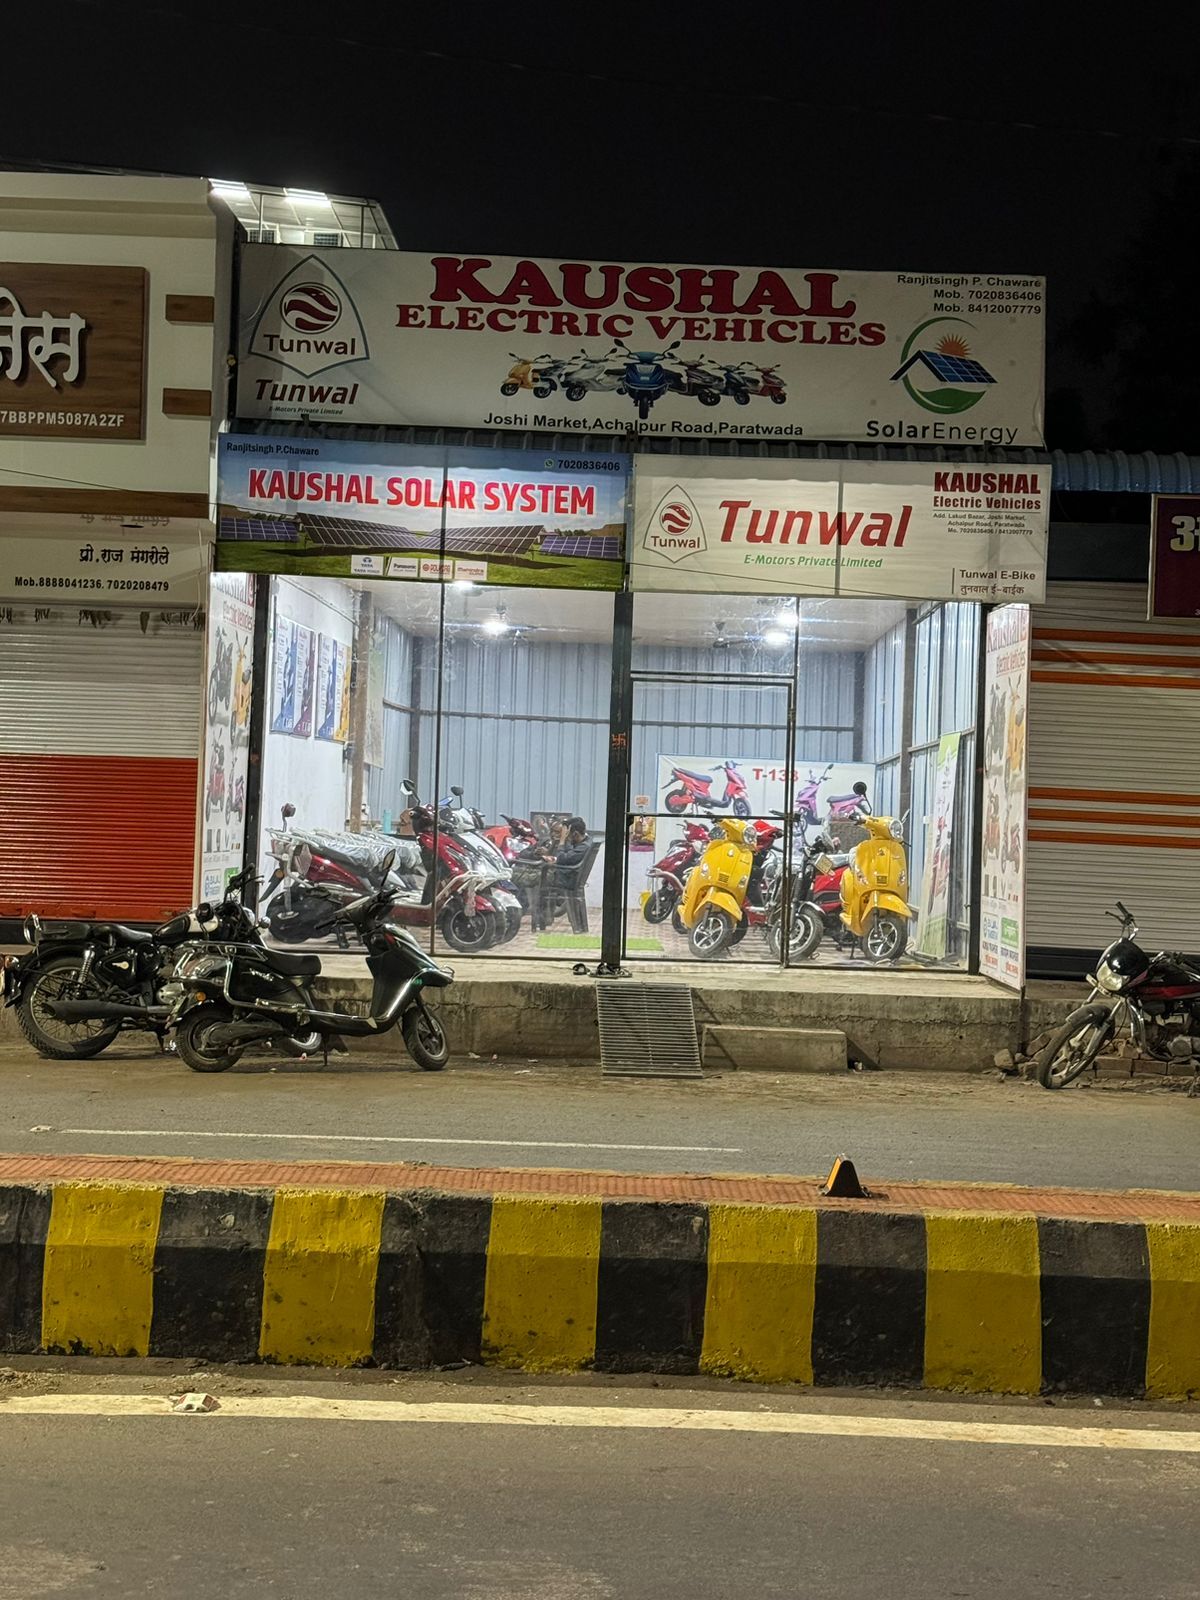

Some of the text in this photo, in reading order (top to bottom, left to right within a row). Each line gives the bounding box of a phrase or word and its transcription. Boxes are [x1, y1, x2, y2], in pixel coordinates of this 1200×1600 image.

[430, 257, 857, 318] KAUSHAL
[897, 274, 1042, 288] Ranjitsingh P. Chaware
[933, 289, 1042, 301] Mob. 7020836406
[933, 303, 1042, 315] Mob. 8412007779
[396, 304, 887, 347] ELECTRIC VEHICLES
[263, 334, 356, 355] Tunwal
[256, 379, 359, 405] Tunwal
[483, 412, 528, 427] Joshi
[866, 419, 1019, 446] SolarEnergy
[227, 442, 274, 455] Ranjitsingh
[558, 459, 620, 471] 7020836406
[934, 471, 1041, 494] KAUSHAL
[249, 468, 596, 516] KAUSHAL SOLAR SYSTEM
[933, 495, 1041, 510] Electric Vehicles
[718, 500, 913, 548] Tunwal
[651, 535, 701, 550] Tunwal
[743, 553, 883, 569] E-Motors Private Limited
[960, 569, 1037, 581] Tunwal E-Bike
[107, 578, 170, 592] 7020208479
[960, 584, 989, 596] तुनवाल
